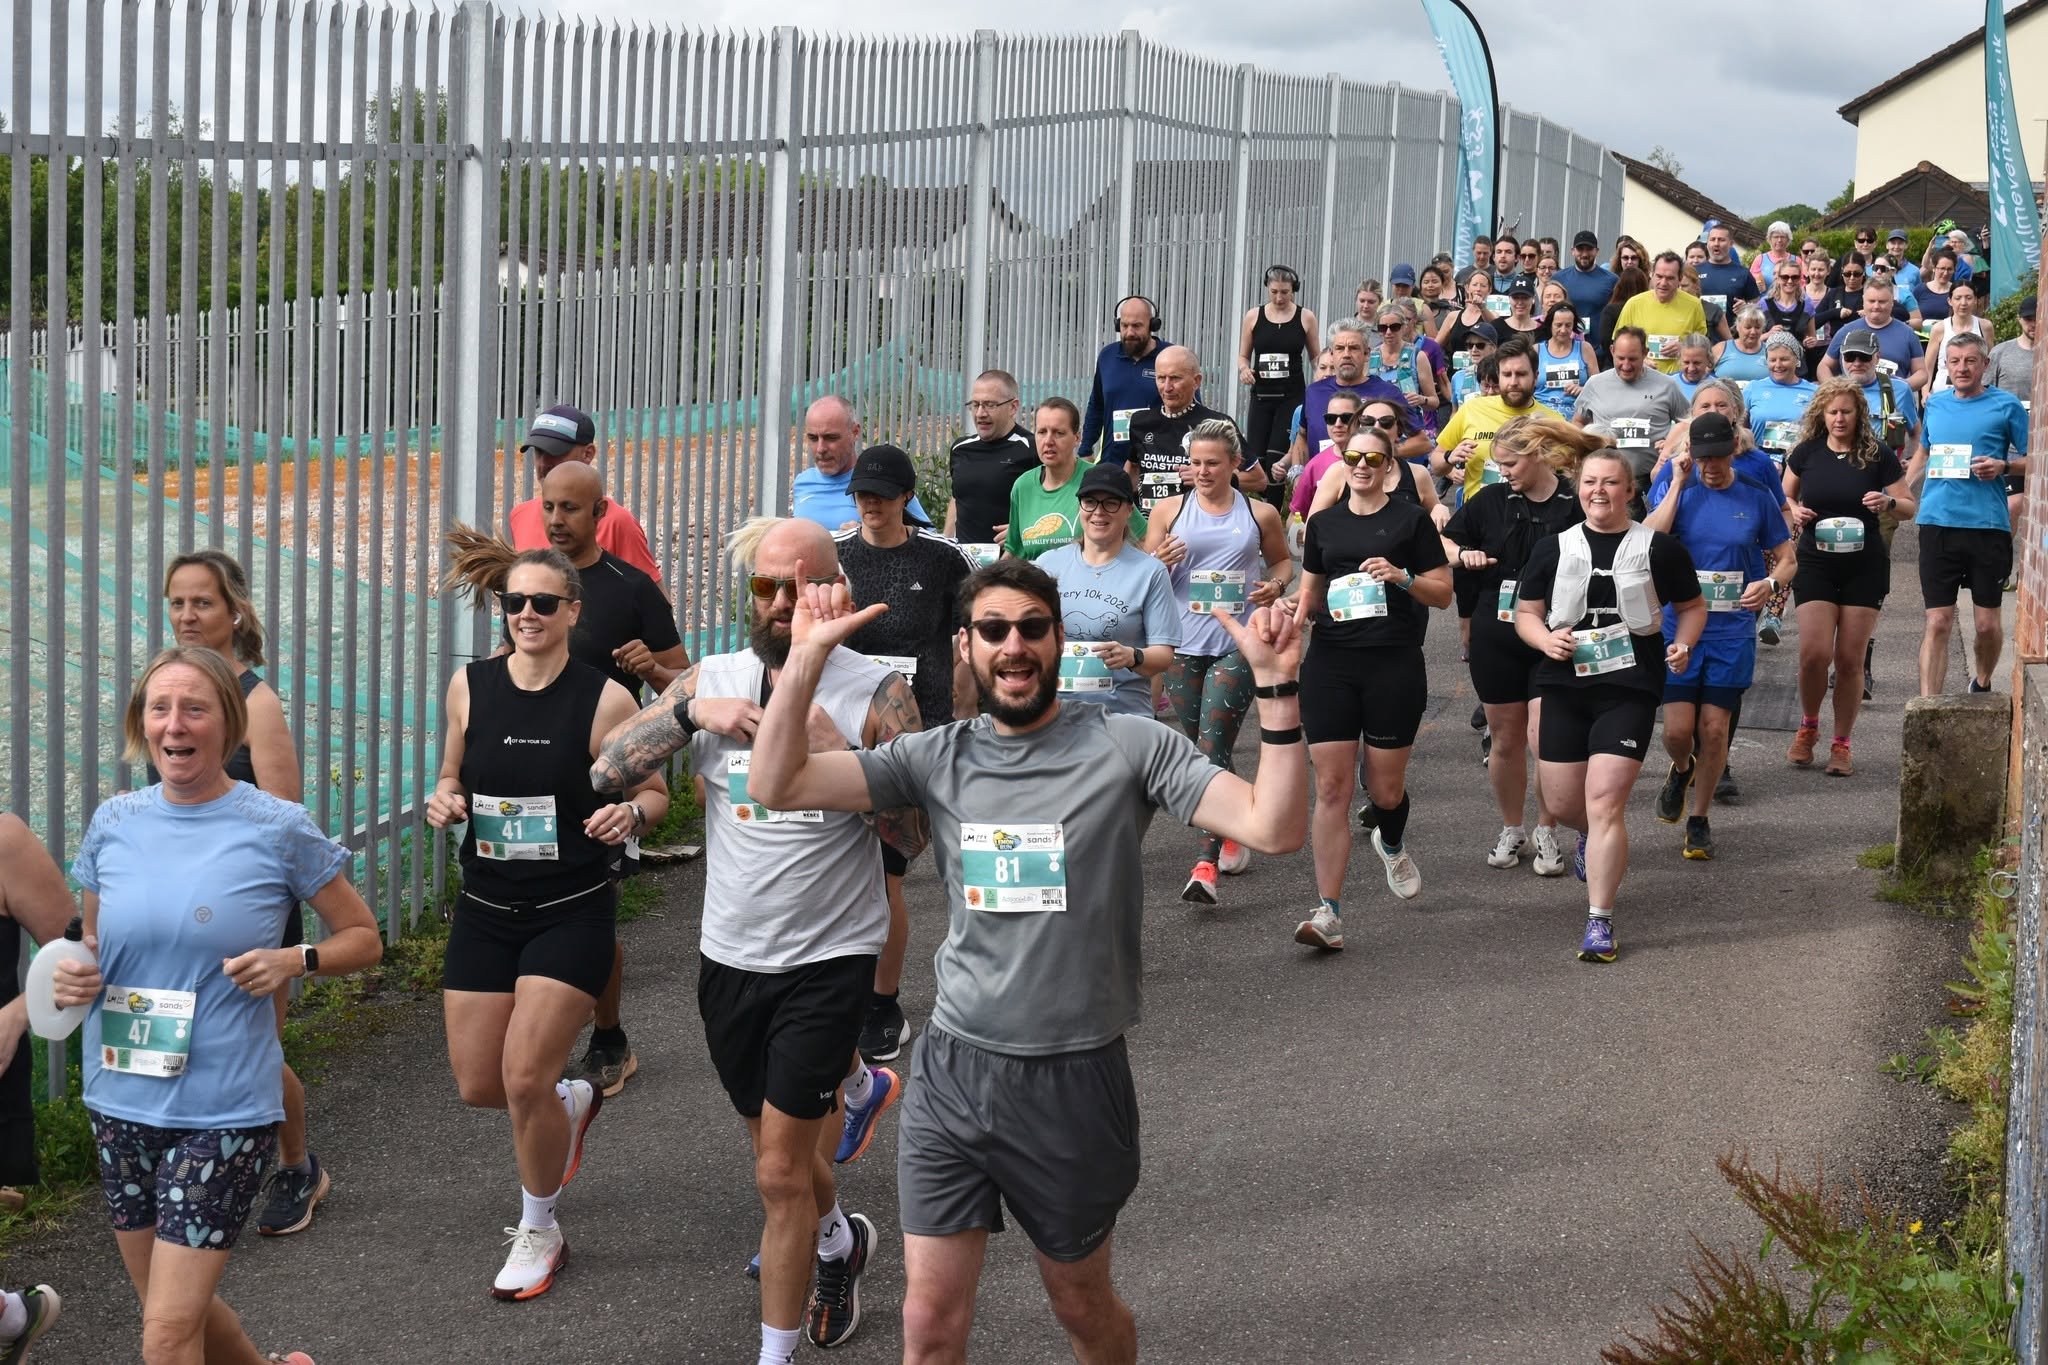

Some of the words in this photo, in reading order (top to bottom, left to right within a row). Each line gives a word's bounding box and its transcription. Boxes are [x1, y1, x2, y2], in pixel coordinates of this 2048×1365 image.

[1268, 362, 1279, 371] 144
[1557, 371, 1569, 380] 101
[1474, 432, 1494, 440] LOND
[1623, 428, 1637, 438] 141
[1144, 453, 1190, 464] DAWLISH
[1151, 485, 1169, 498] 126
[1836, 529, 1843, 541] 9
[1214, 585, 1222, 600] 8
[1349, 588, 1364, 605] 26
[1713, 585, 1726, 599] 12
[1060, 590, 1081, 600] ery
[1084, 588, 1103, 600] 10k
[1103, 594, 1129, 614] 2026
[1593, 644, 1610, 659] 31
[1076, 659, 1084, 675] 7
[502, 820, 522, 840] 41
[963, 834, 975, 842] LM
[1027, 836, 1052, 844] sands
[995, 856, 1020, 883] 81
[1041, 888, 1063, 900] PROTEIN
[159, 1002, 183, 1010] sands
[128, 1019, 152, 1045] 47
